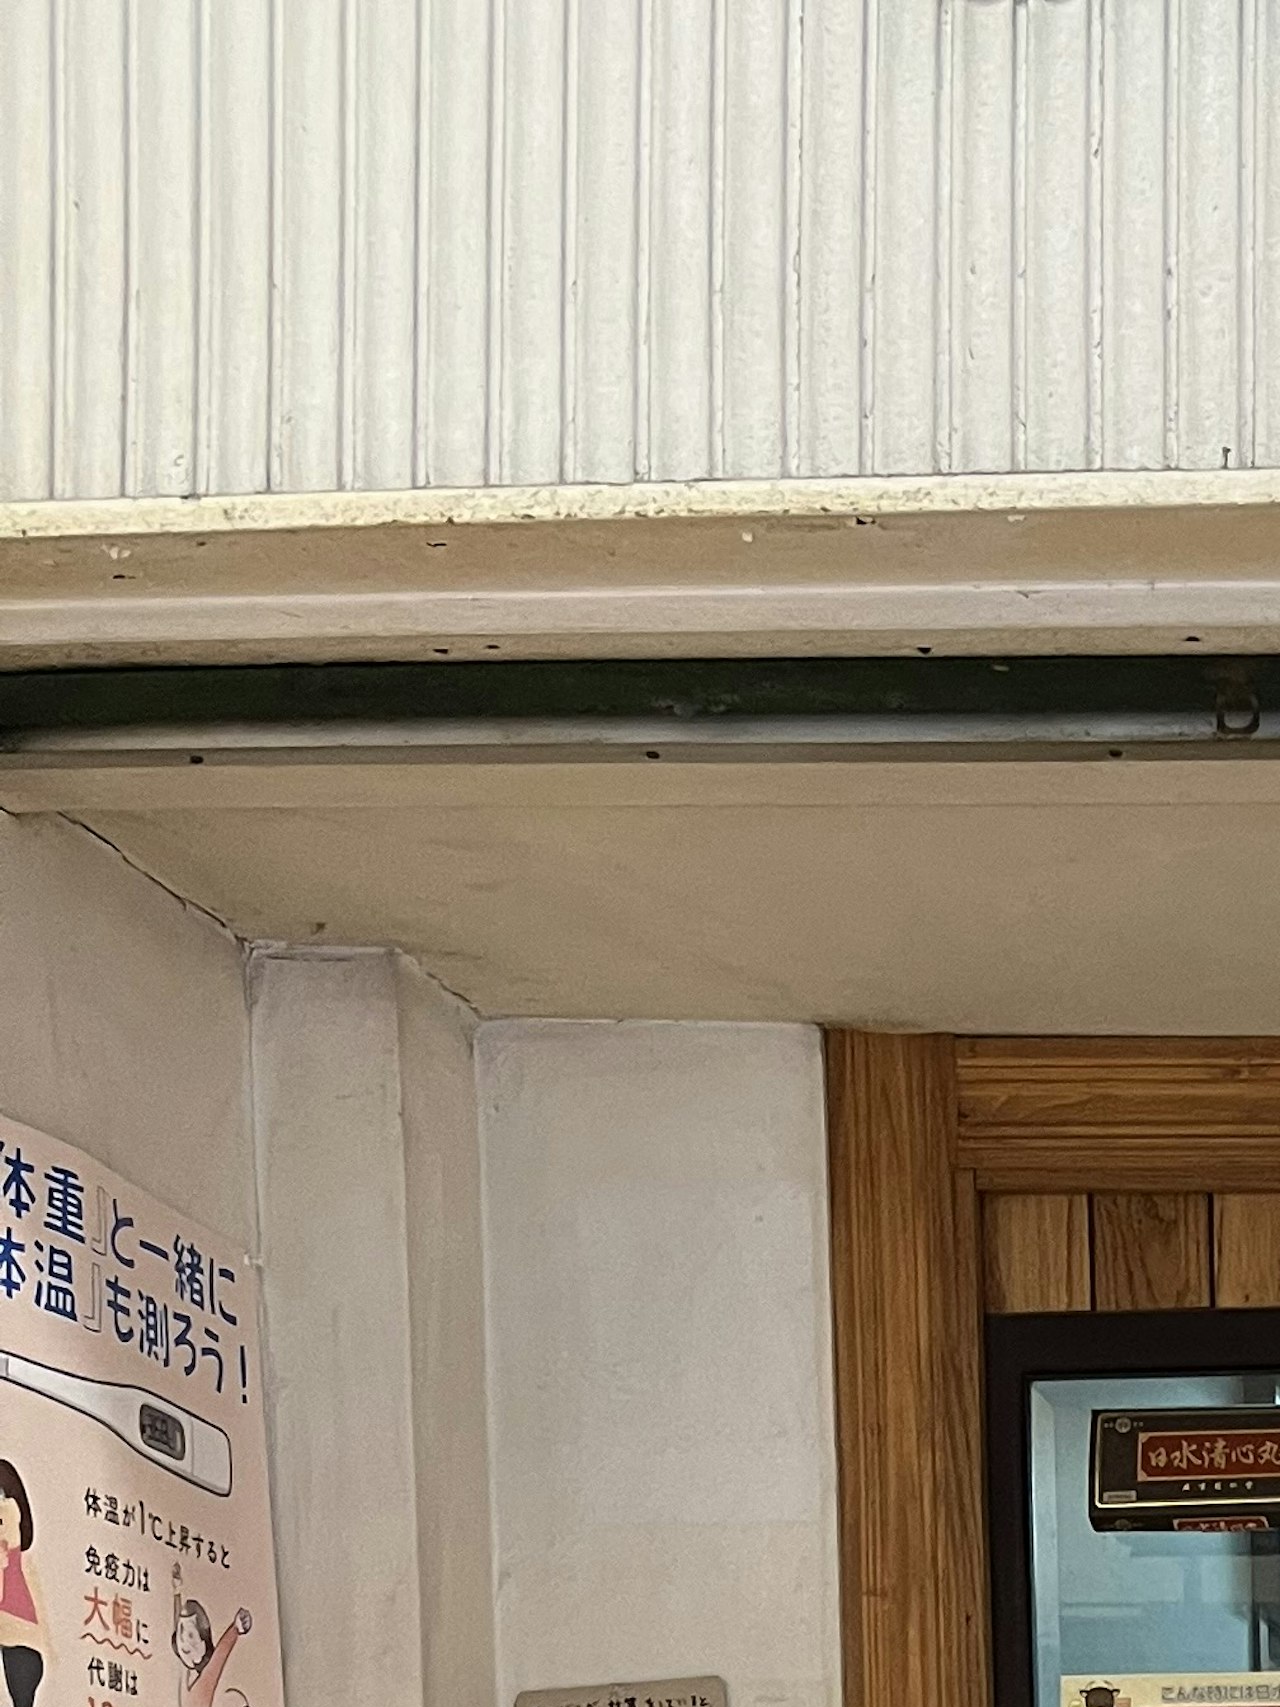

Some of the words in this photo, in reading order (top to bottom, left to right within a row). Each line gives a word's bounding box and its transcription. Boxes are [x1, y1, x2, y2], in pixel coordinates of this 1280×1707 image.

[84, 1543, 150, 1592] 免疫力は
[84, 1587, 149, 1646] 大幅に
[87, 1656, 138, 1696] 代謝は
